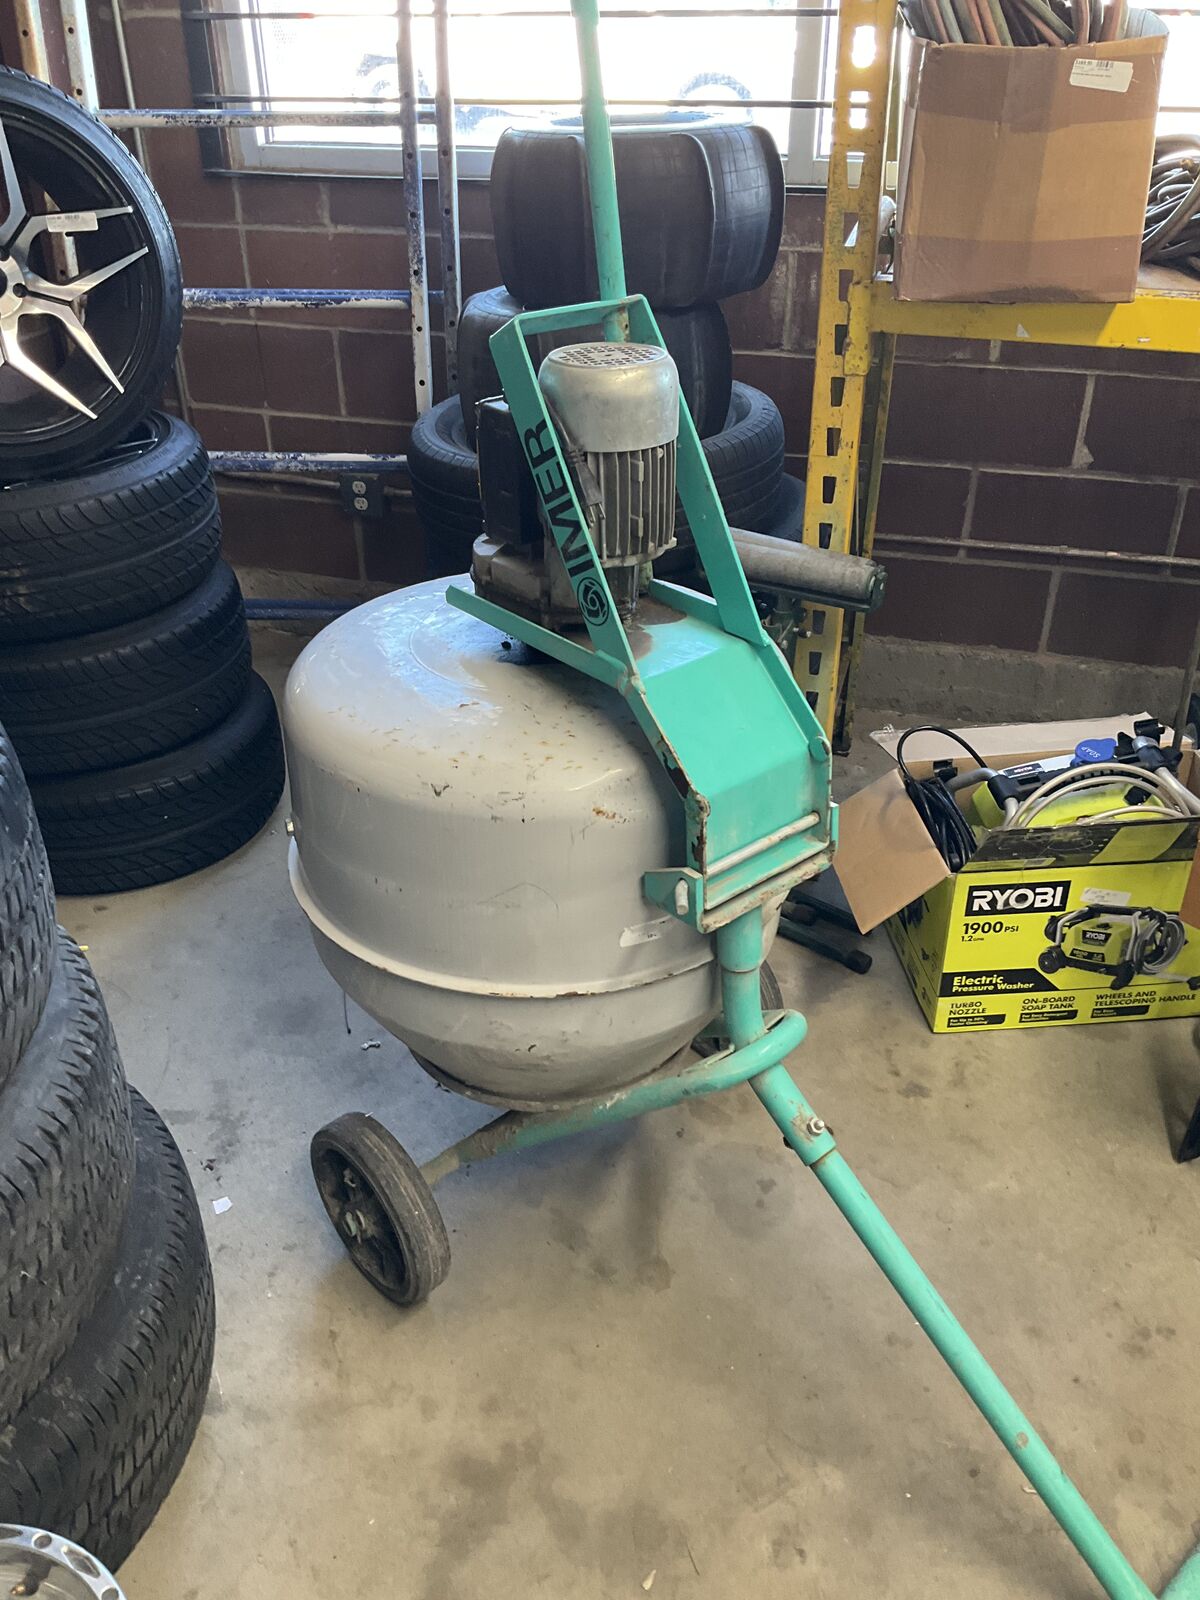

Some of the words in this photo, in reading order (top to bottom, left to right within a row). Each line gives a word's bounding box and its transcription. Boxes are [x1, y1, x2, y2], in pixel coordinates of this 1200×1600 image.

[524, 419, 594, 578] IMER
[972, 886, 1064, 911] RYOBI
[963, 921, 1004, 935] 1900
[1004, 925, 1019, 933] PSI
[953, 974, 1004, 986] Electric
[952, 985, 995, 993] Pressure
[997, 982, 1035, 990] Washer
[1022, 996, 1076, 1005] ON-BOARD
[1095, 997, 1156, 1007] TELESCOPING
[1159, 993, 1197, 1003] HANDLE
[1096, 992, 1132, 1000] WHEELS
[1135, 990, 1157, 998] AND
[951, 1001, 982, 1009] TURBO
[1021, 1003, 1047, 1011] SOAP
[949, 1007, 987, 1016] NOZZLE
